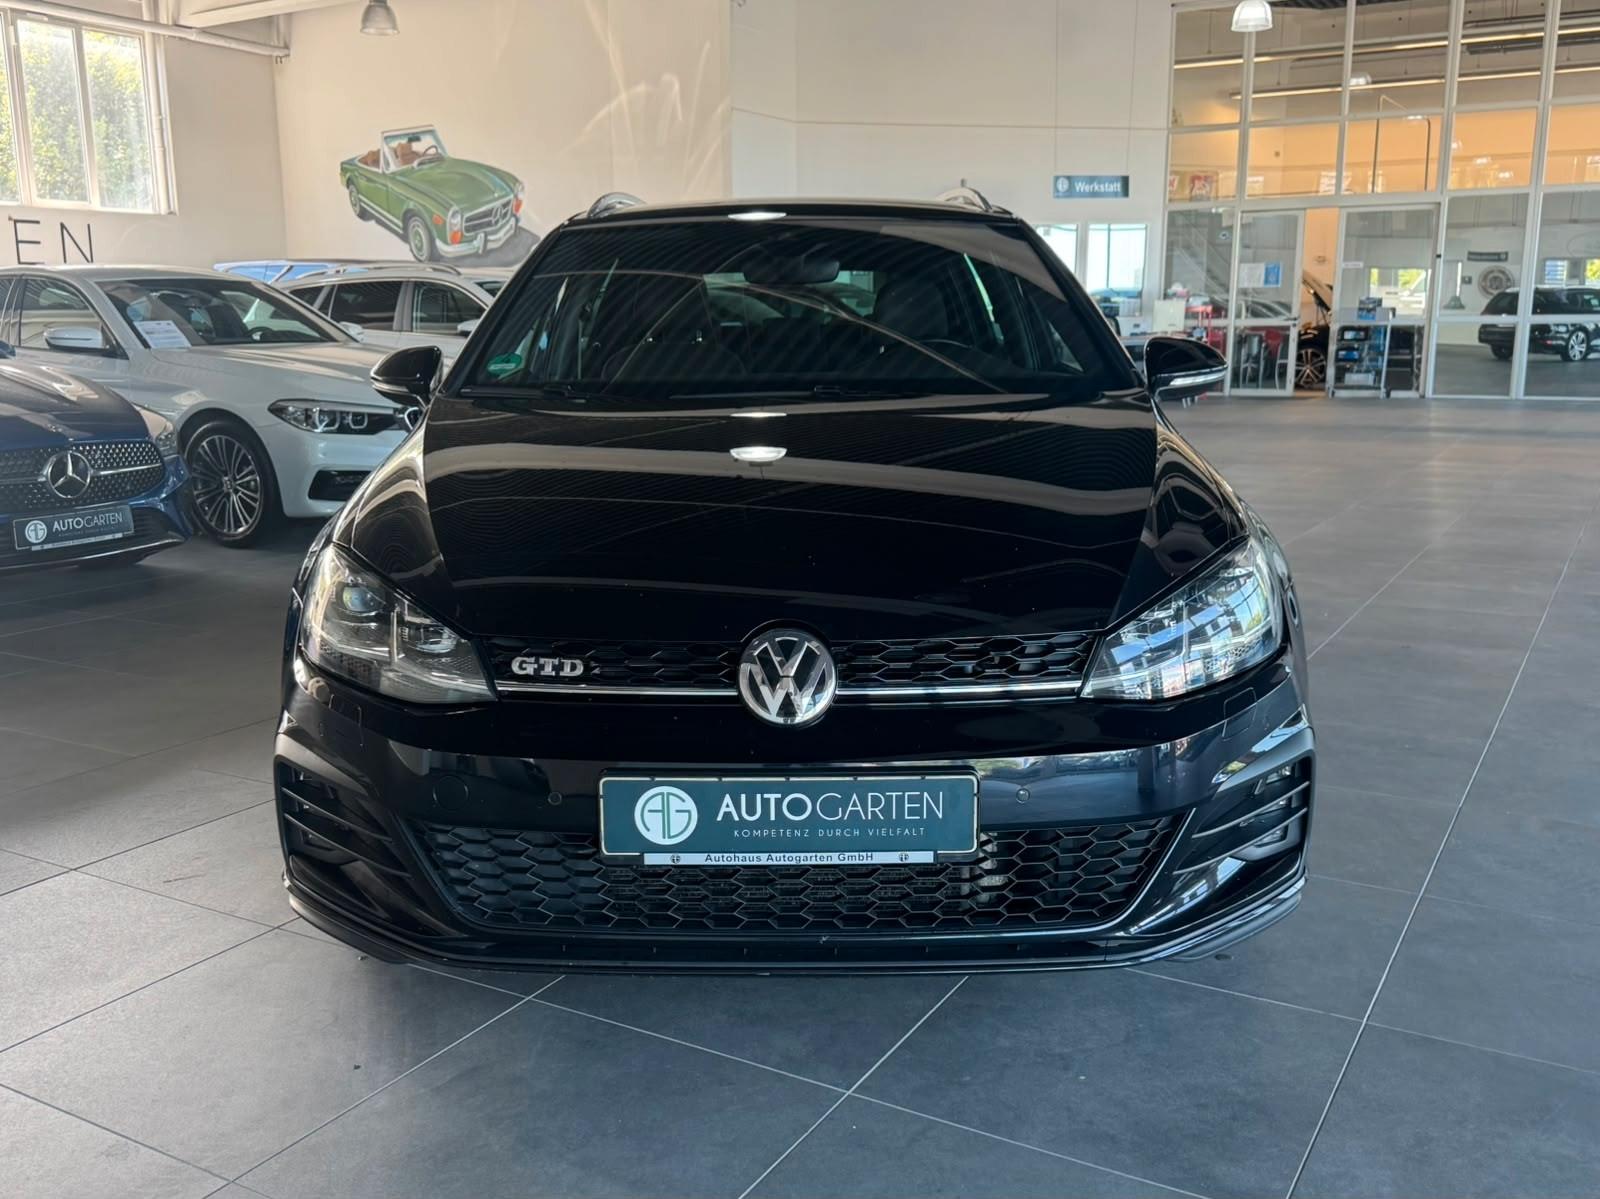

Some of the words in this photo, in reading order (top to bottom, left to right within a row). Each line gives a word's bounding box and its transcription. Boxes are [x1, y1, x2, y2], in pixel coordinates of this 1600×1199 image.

[1074, 180, 1121, 193] Werkstatt
[52, 512, 123, 532] AUTOGARTEN
[511, 656, 585, 677] GTD
[716, 791, 944, 821] AUTOGARTEN
[733, 829, 810, 838] KOMPETENZ
[818, 828, 860, 837] DURCH
[867, 827, 925, 836] VIELFALT
[704, 853, 762, 863] Autohaus
[765, 853, 833, 864] Autogarten
[837, 853, 874, 862] GmbH
